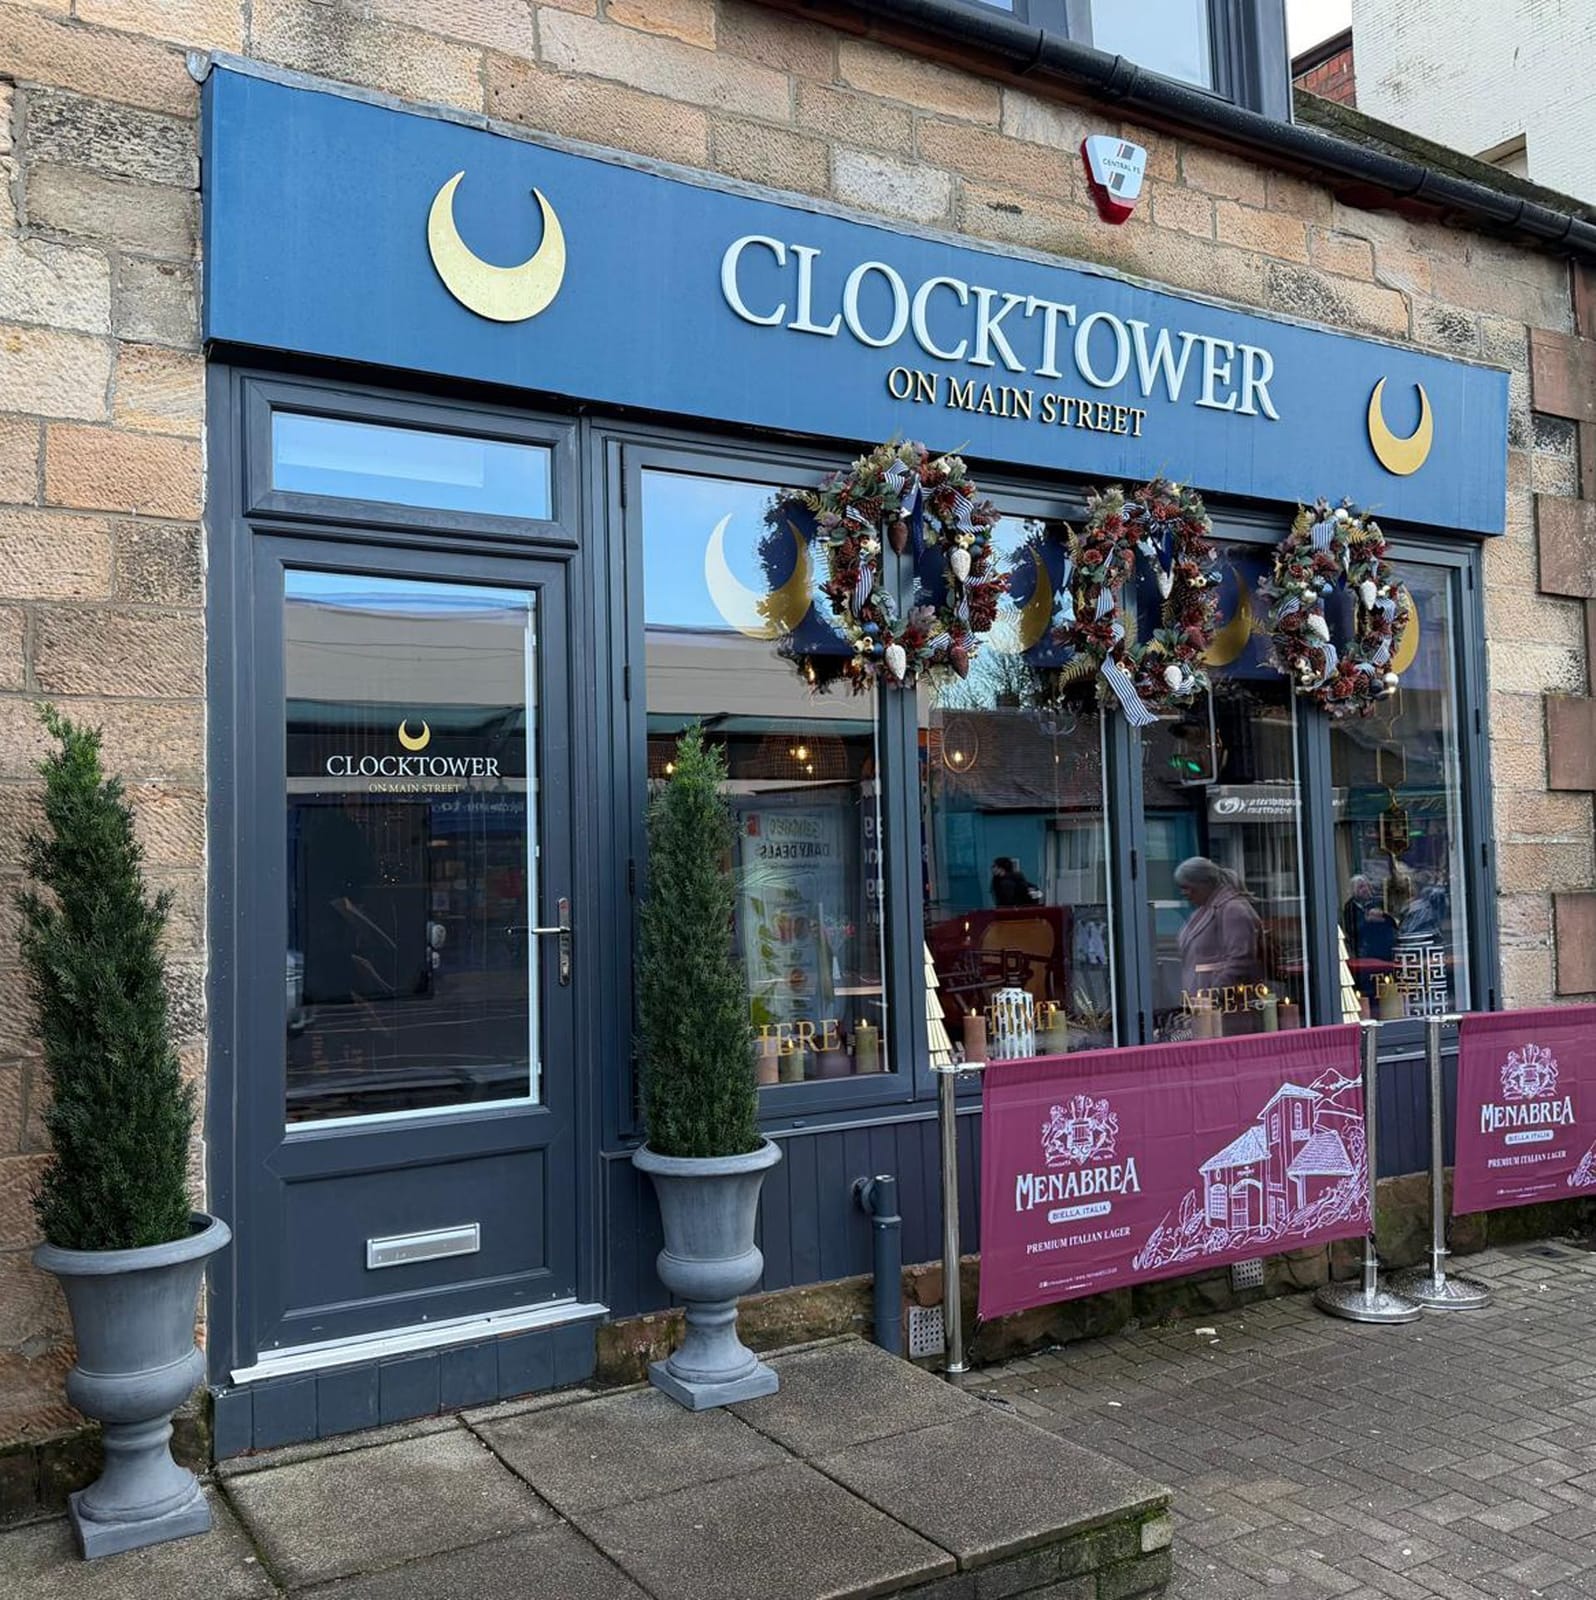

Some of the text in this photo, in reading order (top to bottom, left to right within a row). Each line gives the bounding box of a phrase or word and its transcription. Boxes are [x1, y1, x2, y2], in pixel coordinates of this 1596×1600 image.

[721, 235, 1280, 420] CLOCKTOWER
[887, 366, 1146, 438] ON MAIN STREET
[326, 755, 501, 777] CLOCKTOWER
[368, 783, 462, 794] ON MAIN STREET
[1488, 1150, 1567, 1168] PREMIUM ITALIAN LAGER
[1052, 1203, 1108, 1221] BIELLA ITALIA
[1026, 1226, 1131, 1255] PREMIUM ITALIAN LAGER
